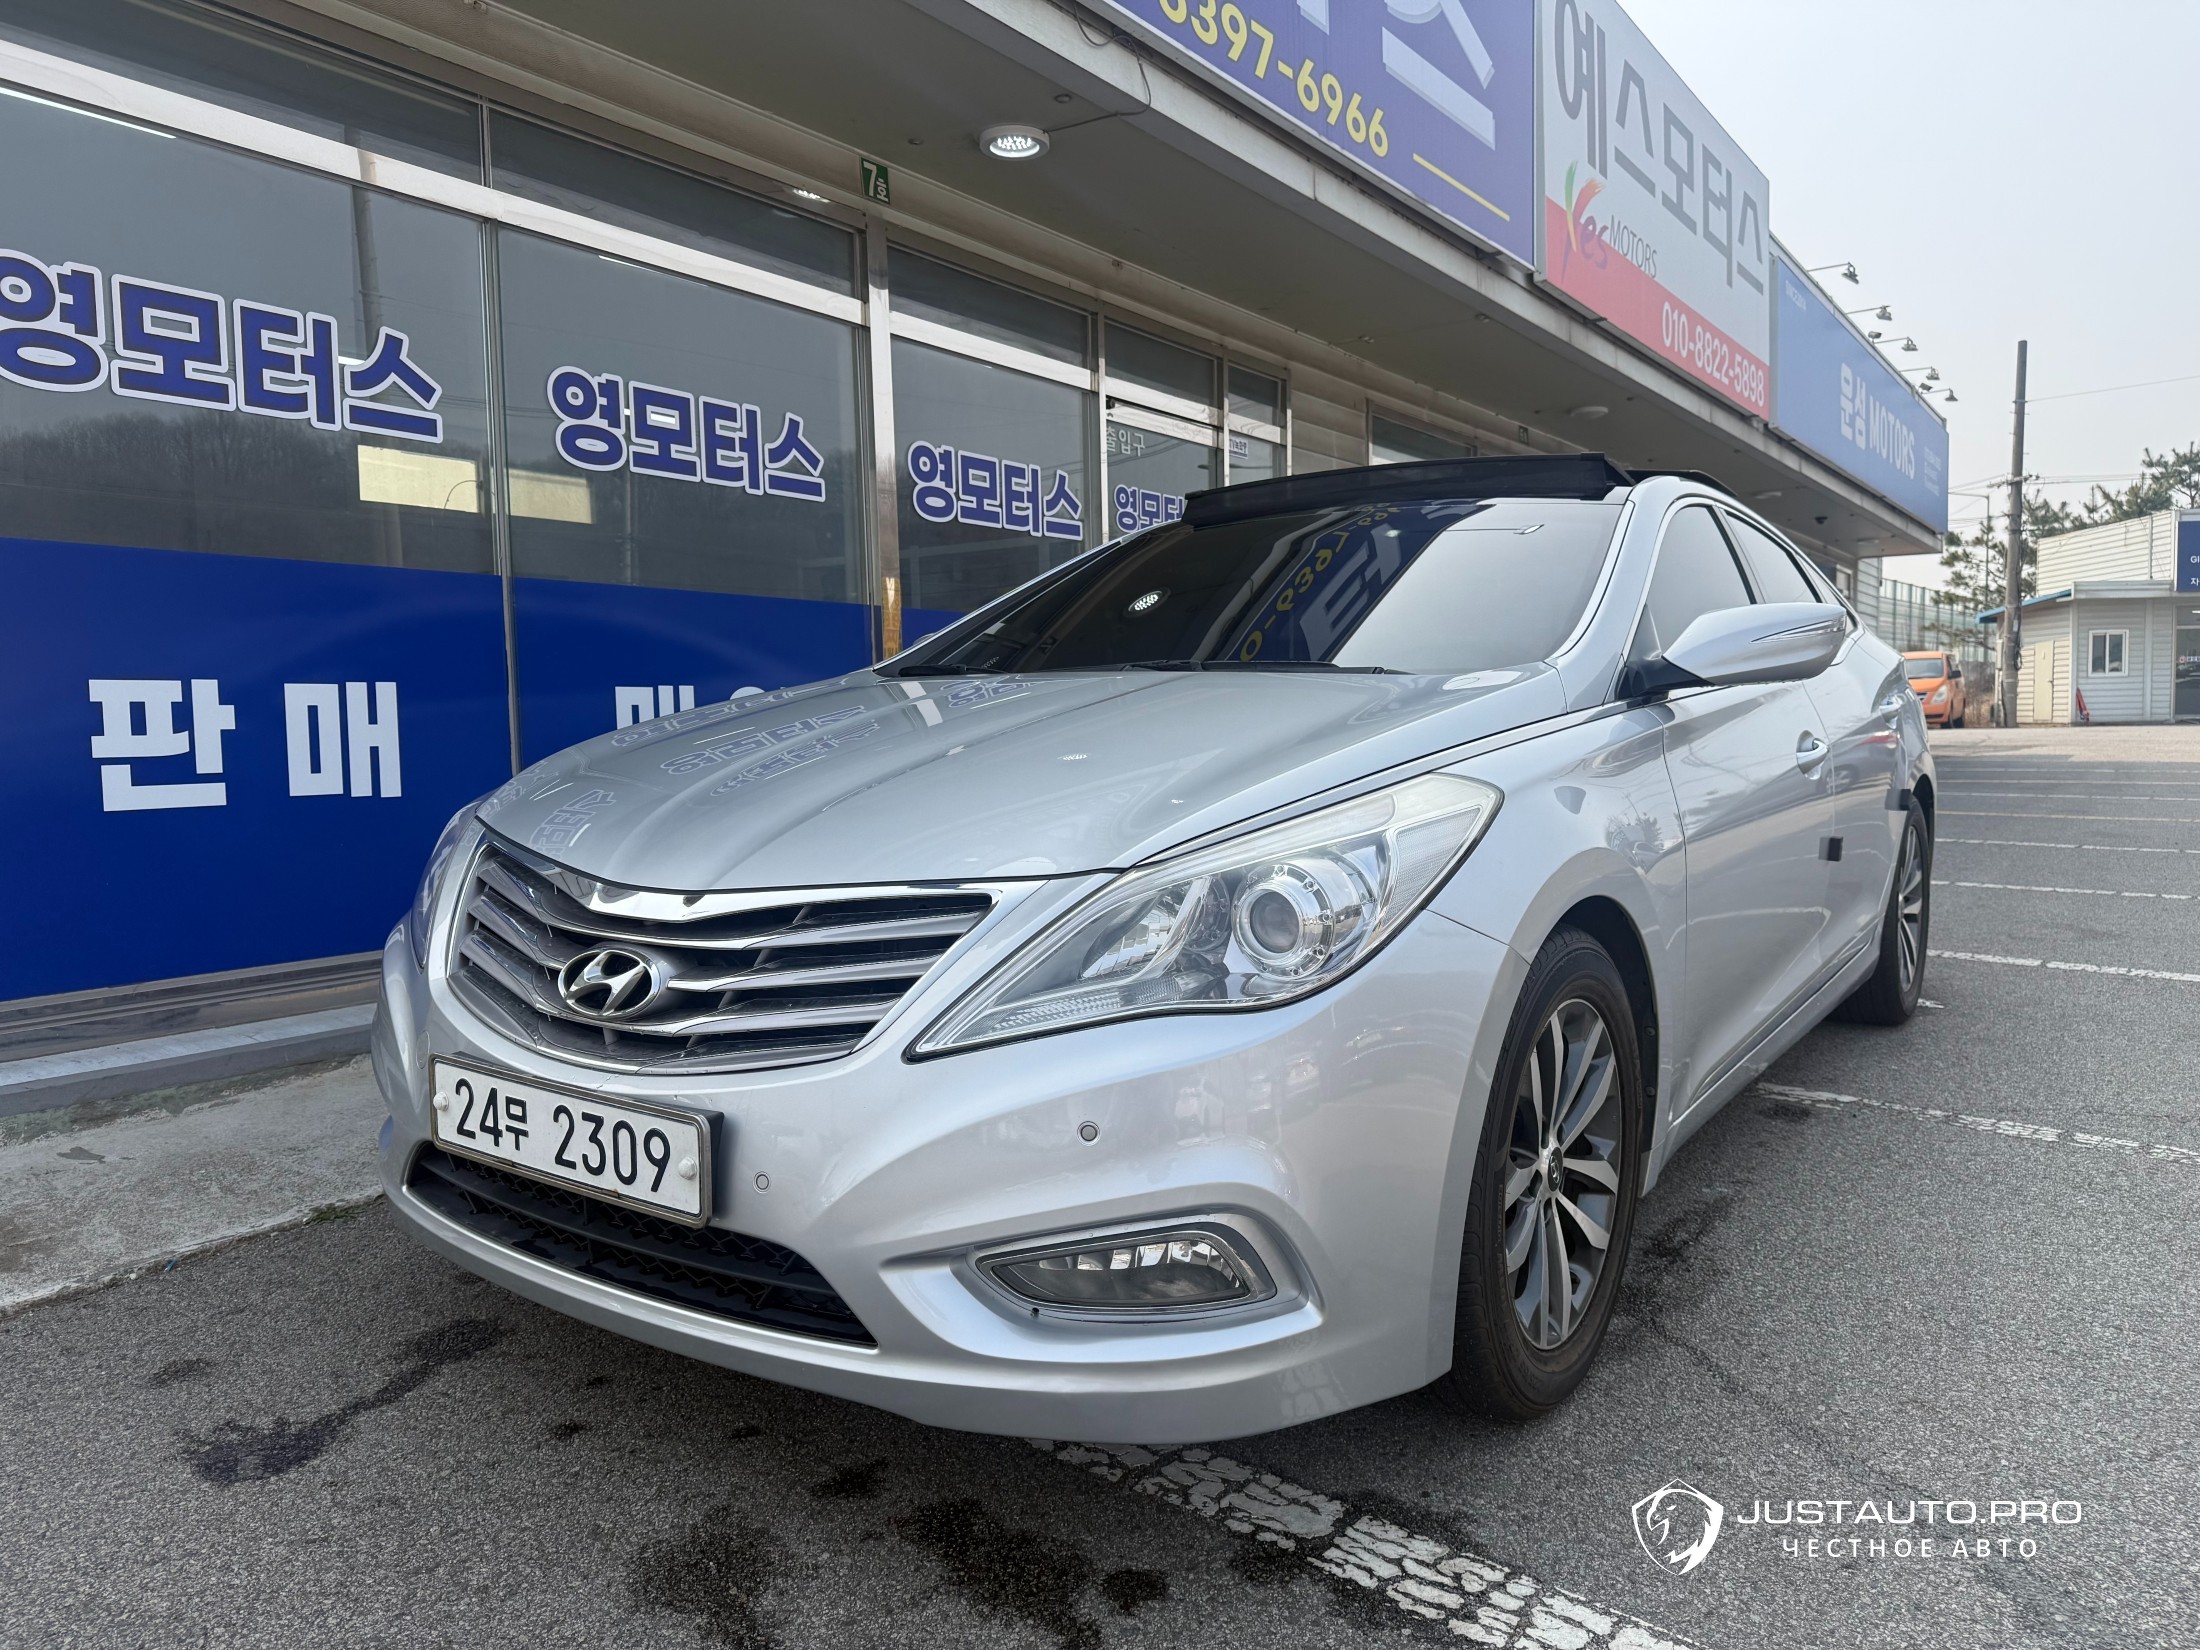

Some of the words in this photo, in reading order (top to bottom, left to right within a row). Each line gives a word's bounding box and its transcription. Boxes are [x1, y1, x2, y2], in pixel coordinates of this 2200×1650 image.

[862, 160, 889, 202] 7호
[1554, 0, 1764, 295] 예스모터스
[1609, 214, 1658, 279] MOTORS
[0, 248, 444, 443] 영모터스
[1662, 301, 1765, 407] 010-8822-5898
[547, 366, 826, 502] 영모터스
[1869, 395, 1915, 480] MOTORS
[907, 440, 1085, 541] 영모터스
[455, 1078, 529, 1151] 24무
[553, 1104, 671, 1193] 2309
